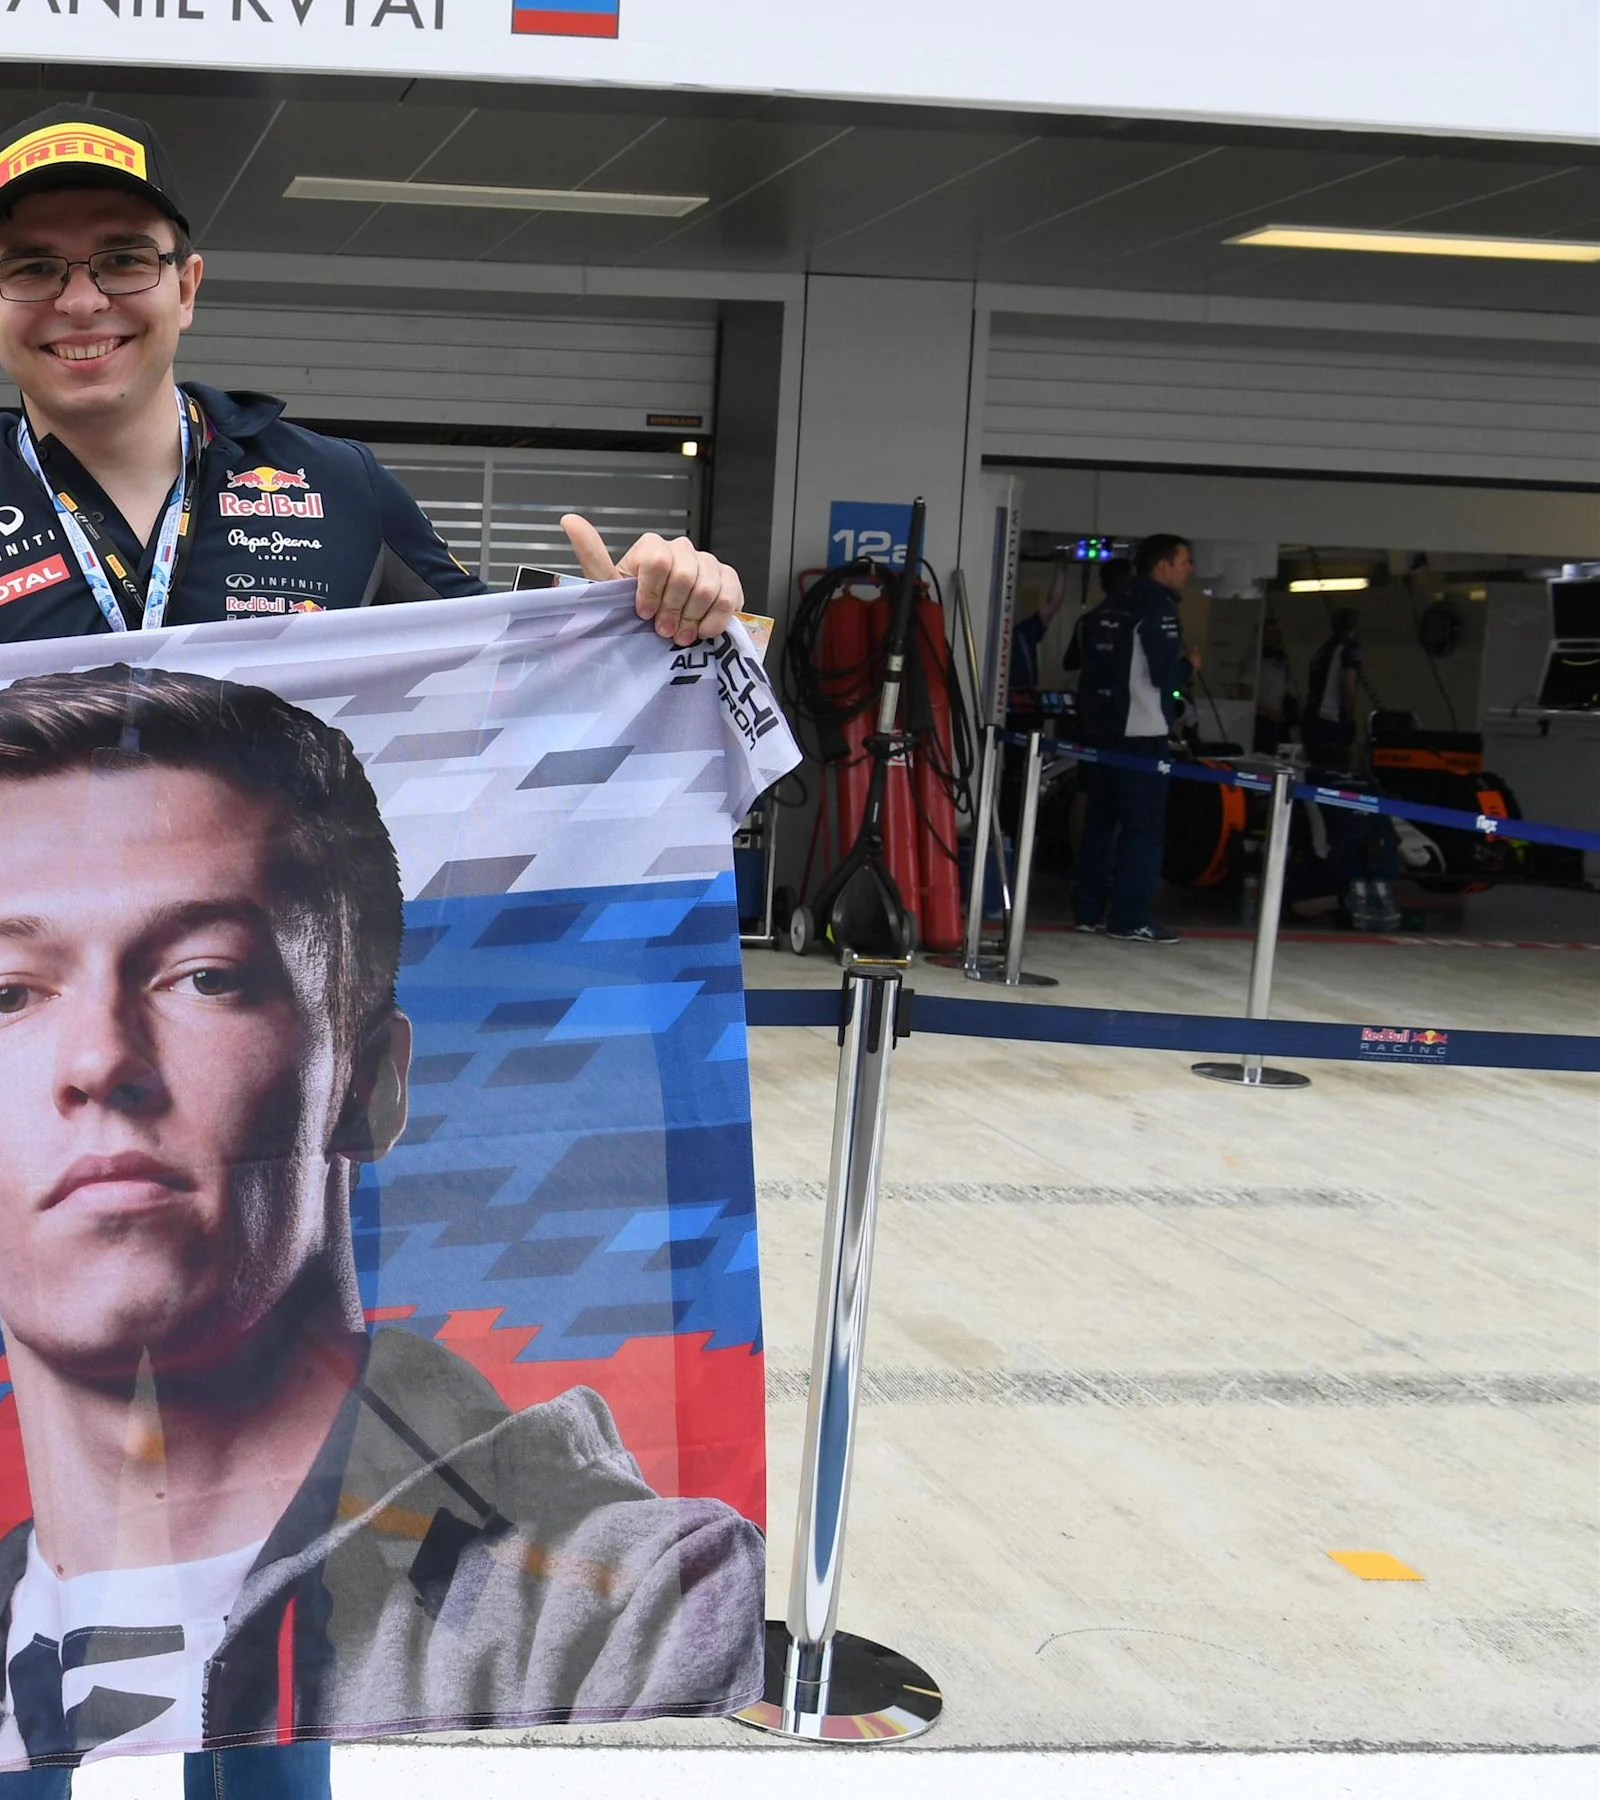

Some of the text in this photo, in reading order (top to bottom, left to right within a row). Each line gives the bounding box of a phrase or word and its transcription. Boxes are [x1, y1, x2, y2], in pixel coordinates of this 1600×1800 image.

[228, 529, 322, 553] Pepe Jeans
[261, 577, 329, 592] INFINITI
[1360, 1043, 1446, 1055] RACING
